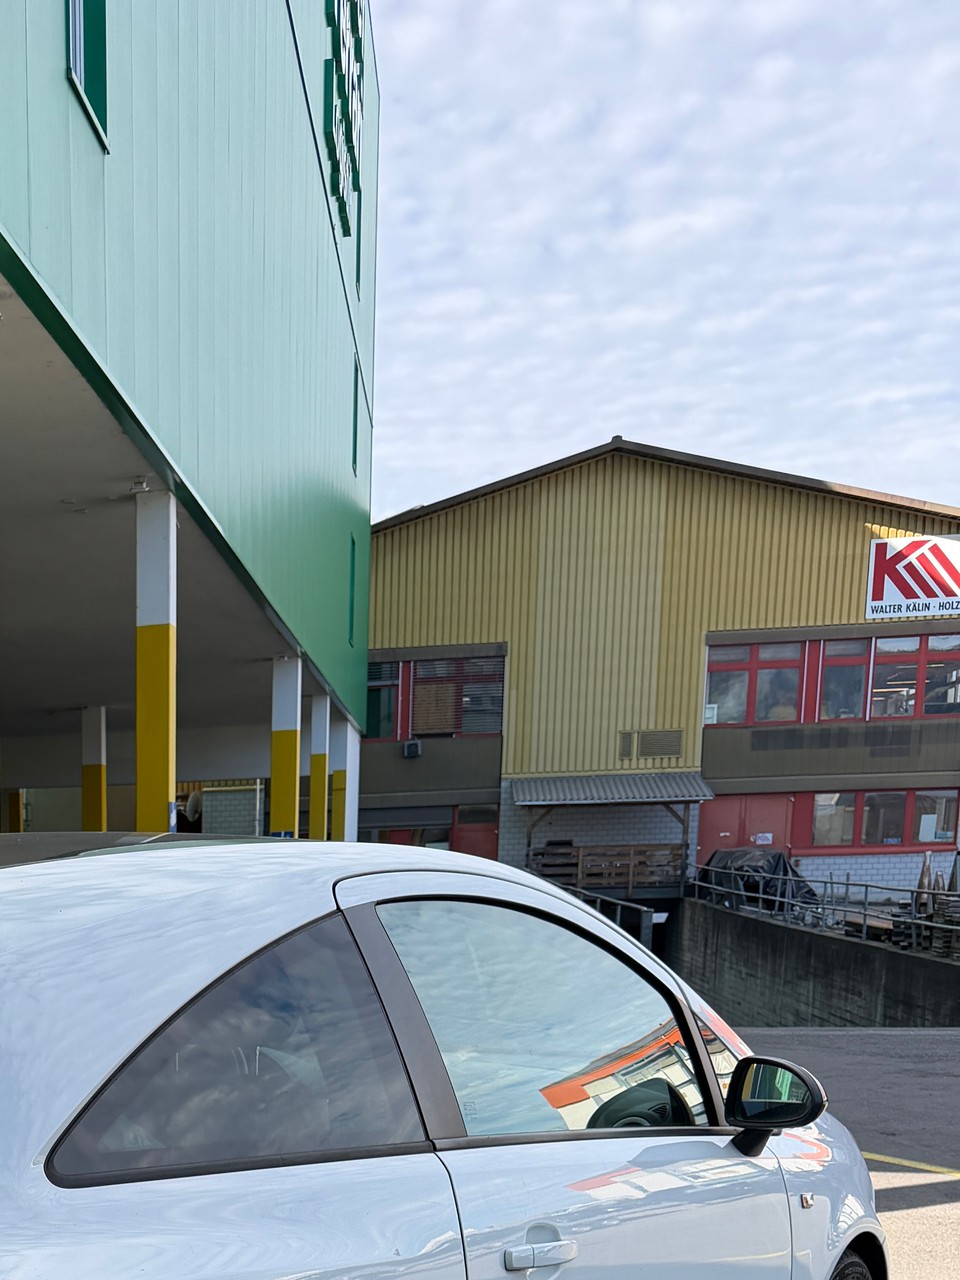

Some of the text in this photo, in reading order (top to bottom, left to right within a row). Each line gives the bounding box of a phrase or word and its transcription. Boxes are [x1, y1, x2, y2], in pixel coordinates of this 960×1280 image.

[871, 600, 960, 615] WALTER KÄLIN HOLZ
